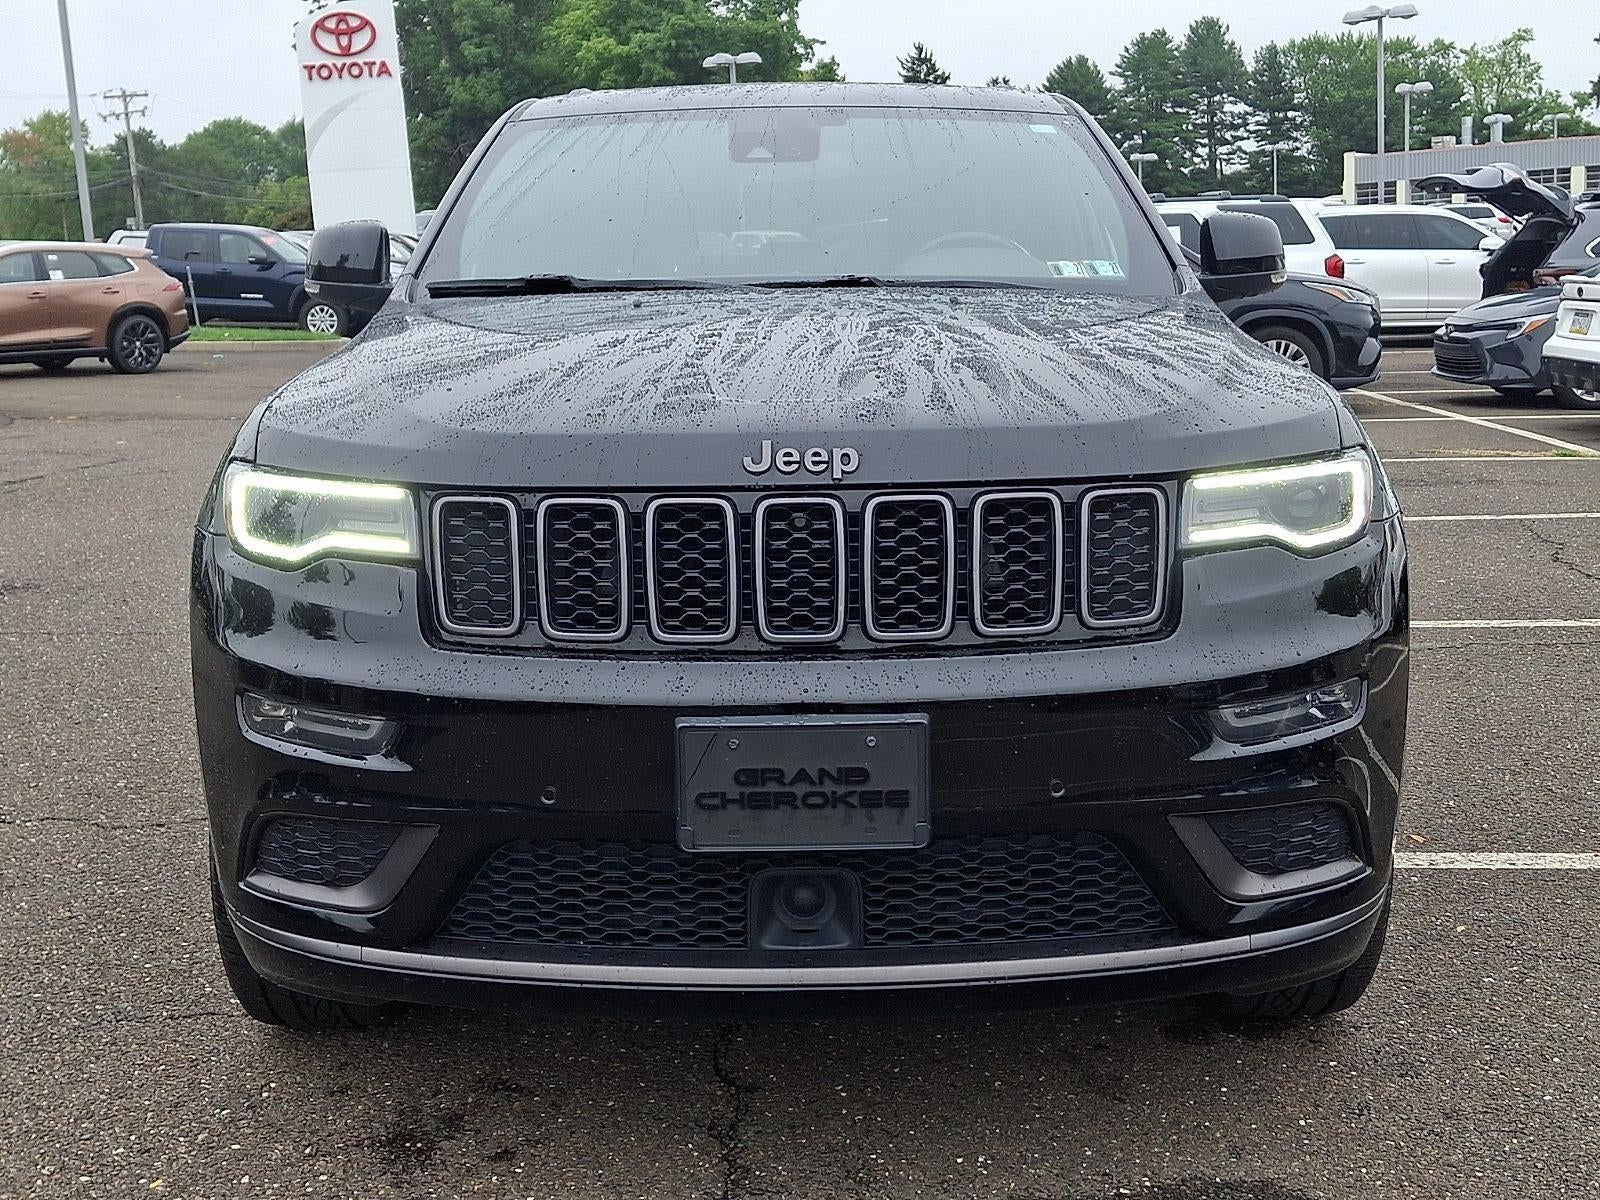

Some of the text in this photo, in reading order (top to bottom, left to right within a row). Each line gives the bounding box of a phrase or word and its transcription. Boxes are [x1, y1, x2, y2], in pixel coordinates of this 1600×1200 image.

[303, 60, 392, 80] TOYOTA
[742, 439, 859, 481] Jeep
[733, 766, 870, 786] GRAND
[694, 789, 910, 811] CHEROKEE
